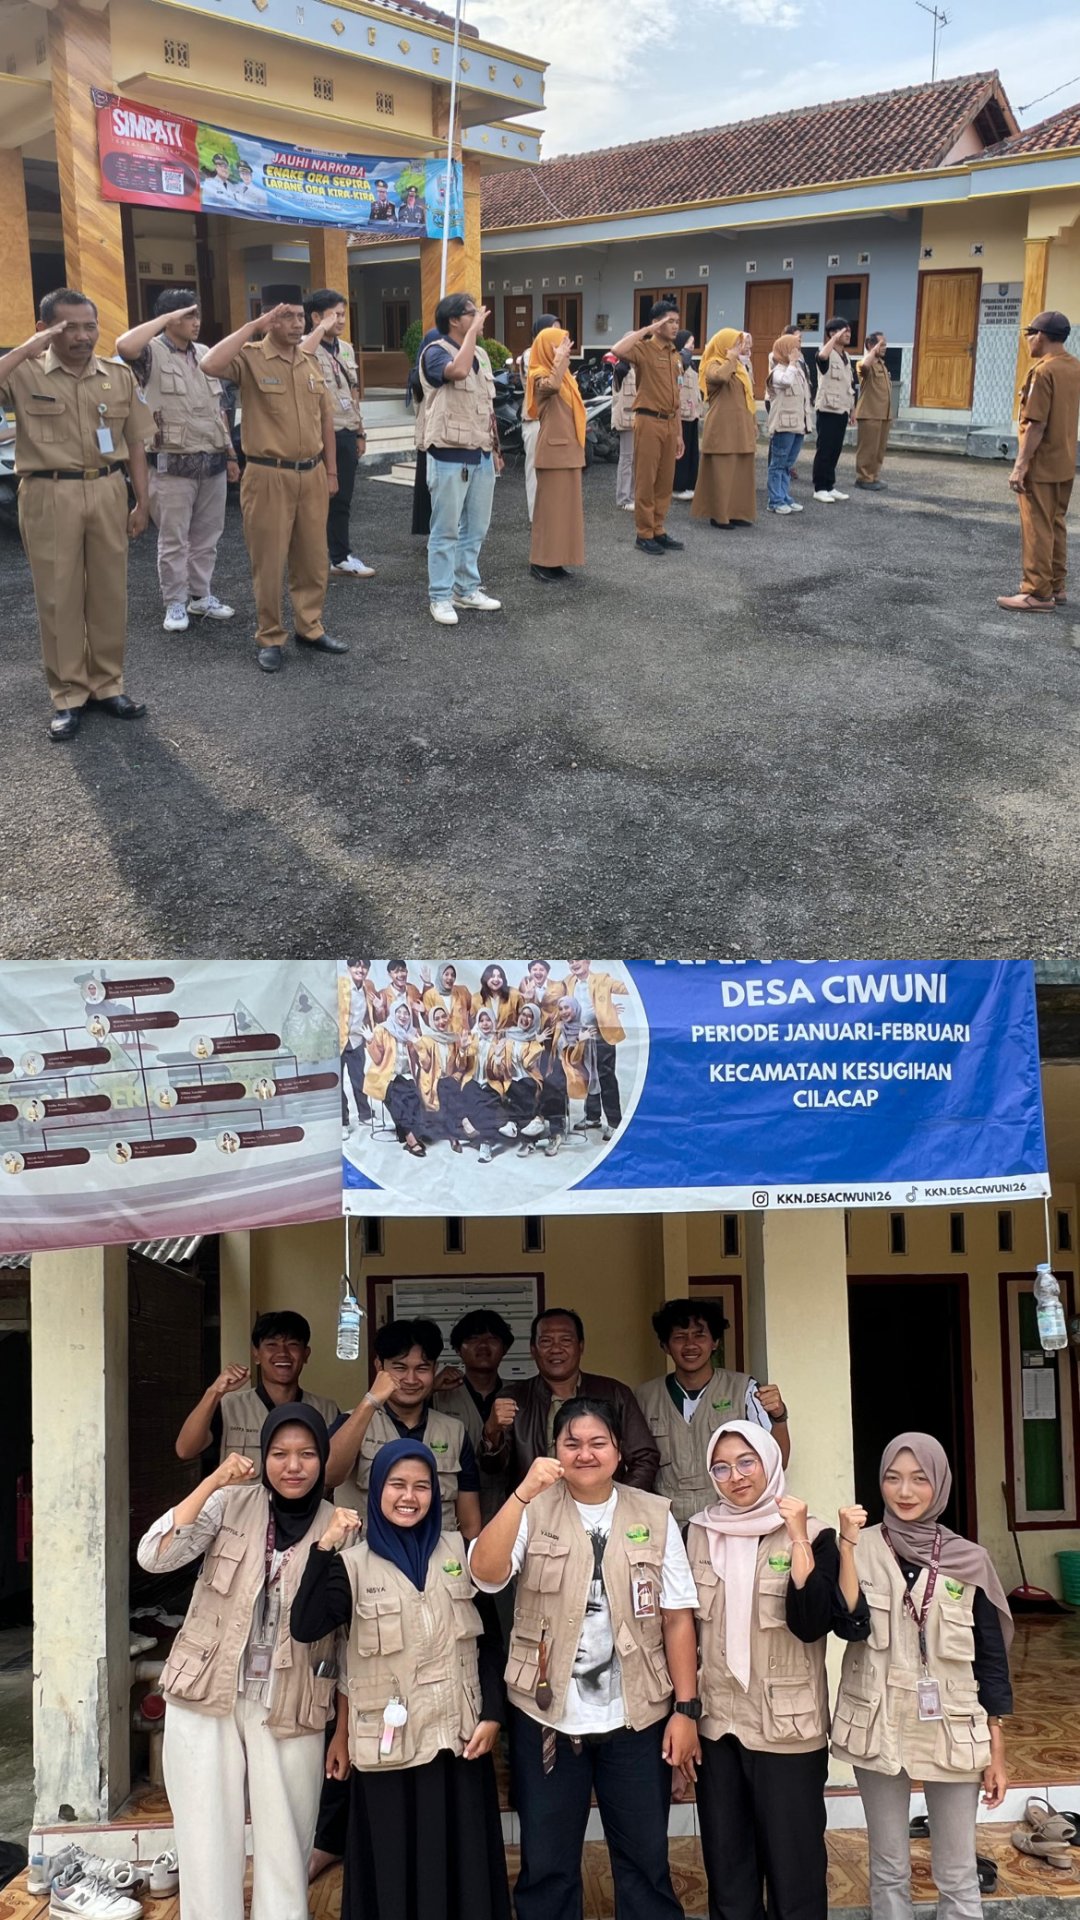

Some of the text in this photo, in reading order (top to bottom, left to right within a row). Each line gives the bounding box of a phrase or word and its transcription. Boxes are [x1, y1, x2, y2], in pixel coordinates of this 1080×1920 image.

[112, 108, 183, 148] SIMPATI
[271, 152, 309, 169] JAUHI
[311, 160, 365, 178] NARKOBA
[266, 166, 371, 191] ENAKE ORA SEPIRA
[264, 178, 303, 193] LARANE
[305, 184, 326, 196] ORA
[328, 188, 376, 203] KIRA-KIRA
[721, 973, 948, 1008] DESA CIWUNI
[691, 1022, 971, 1043] PERIODE JANUARI-FEBRUARI
[709, 1061, 952, 1083] KECAMATAN KESUGIHAN
[793, 1089, 879, 1109] CILACAP
[777, 1191, 892, 1205] KKN.DESACIWUNI26
[924, 1181, 1027, 1198] KKN.DESACIWUNI26
